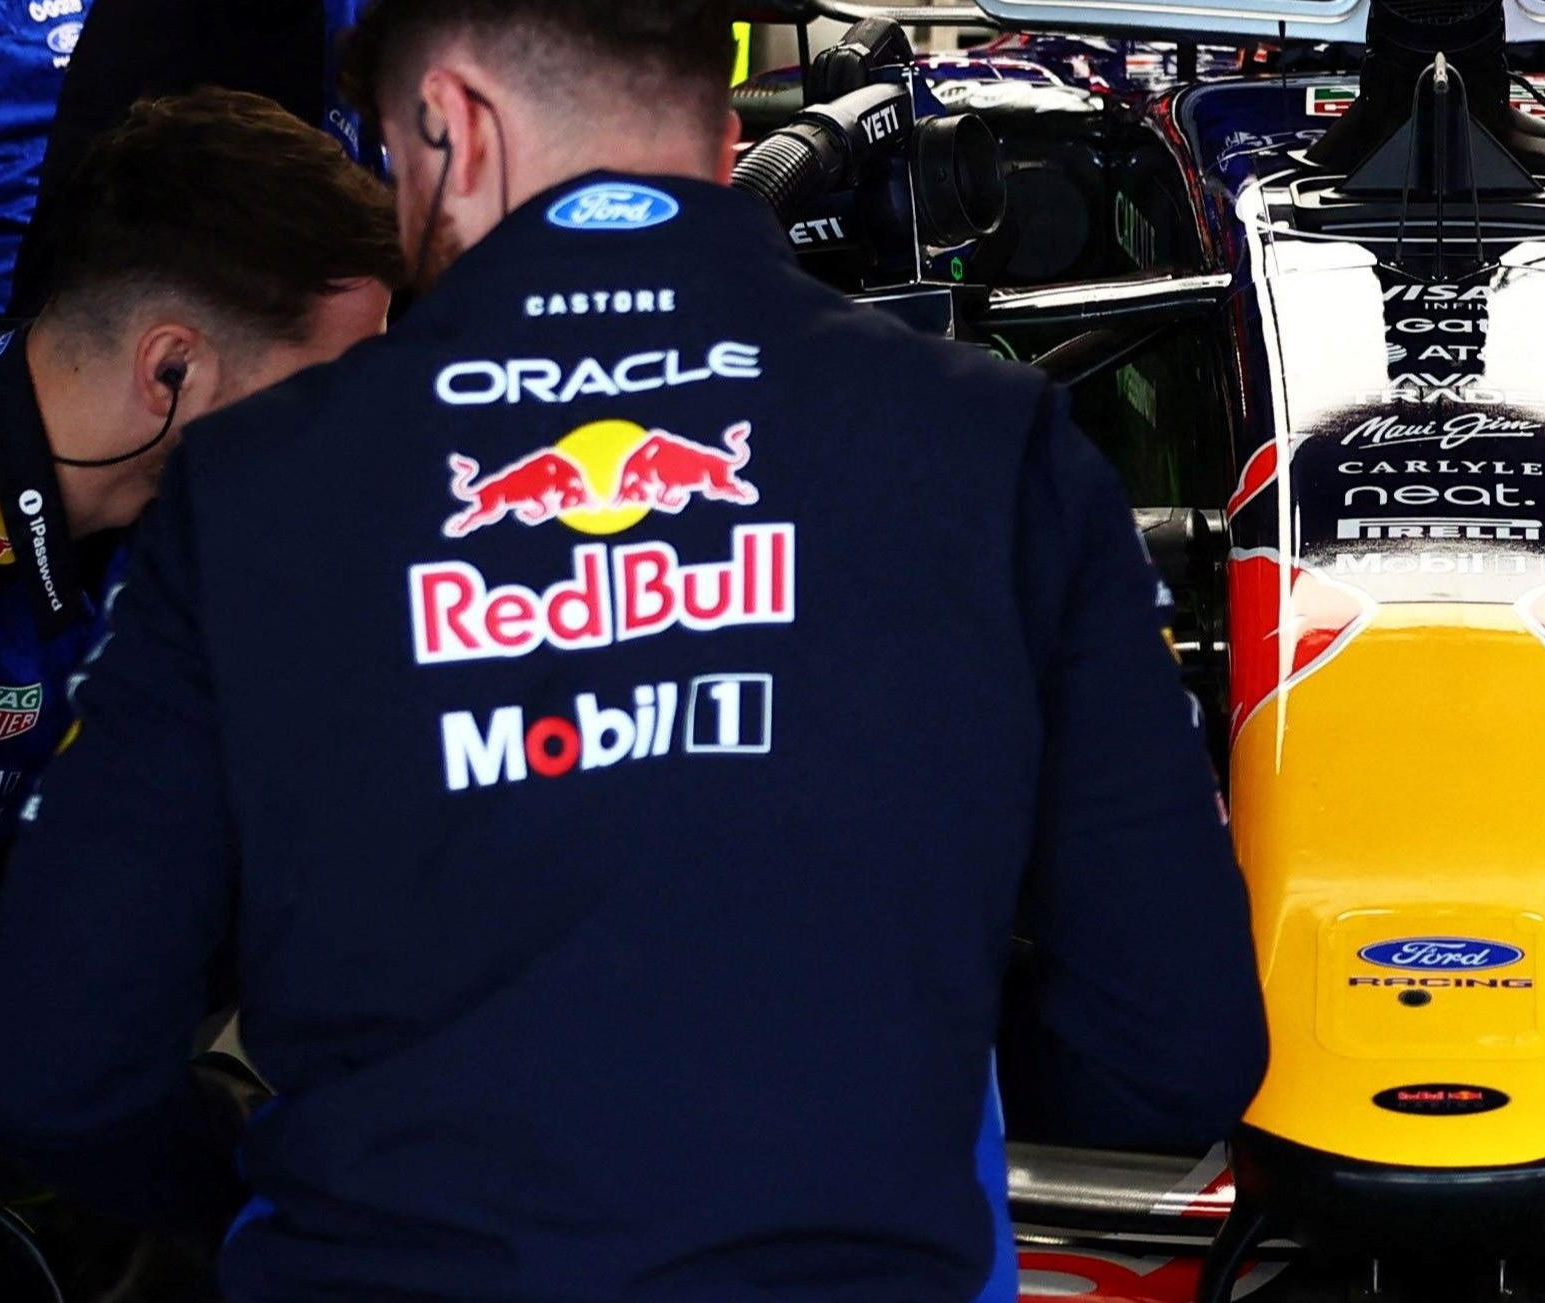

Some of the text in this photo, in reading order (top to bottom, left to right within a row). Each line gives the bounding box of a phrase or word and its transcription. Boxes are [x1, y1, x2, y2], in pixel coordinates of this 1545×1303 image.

[860, 104, 898, 146] YETI
[570, 192, 653, 224] Ford
[788, 216, 843, 245] ETI
[525, 288, 677, 318] CASTORE
[436, 341, 762, 405] ORACLE
[1340, 413, 1544, 449] Maui Jim
[1337, 461, 1544, 477] CARLYLE
[1337, 518, 1543, 540] PIRELLI
[28, 516, 62, 612] 1Password
[1336, 552, 1484, 574] Mobil
[440, 681, 679, 791] Mobil
[1391, 941, 1492, 967] Ford
[1348, 977, 1534, 989] RACING
